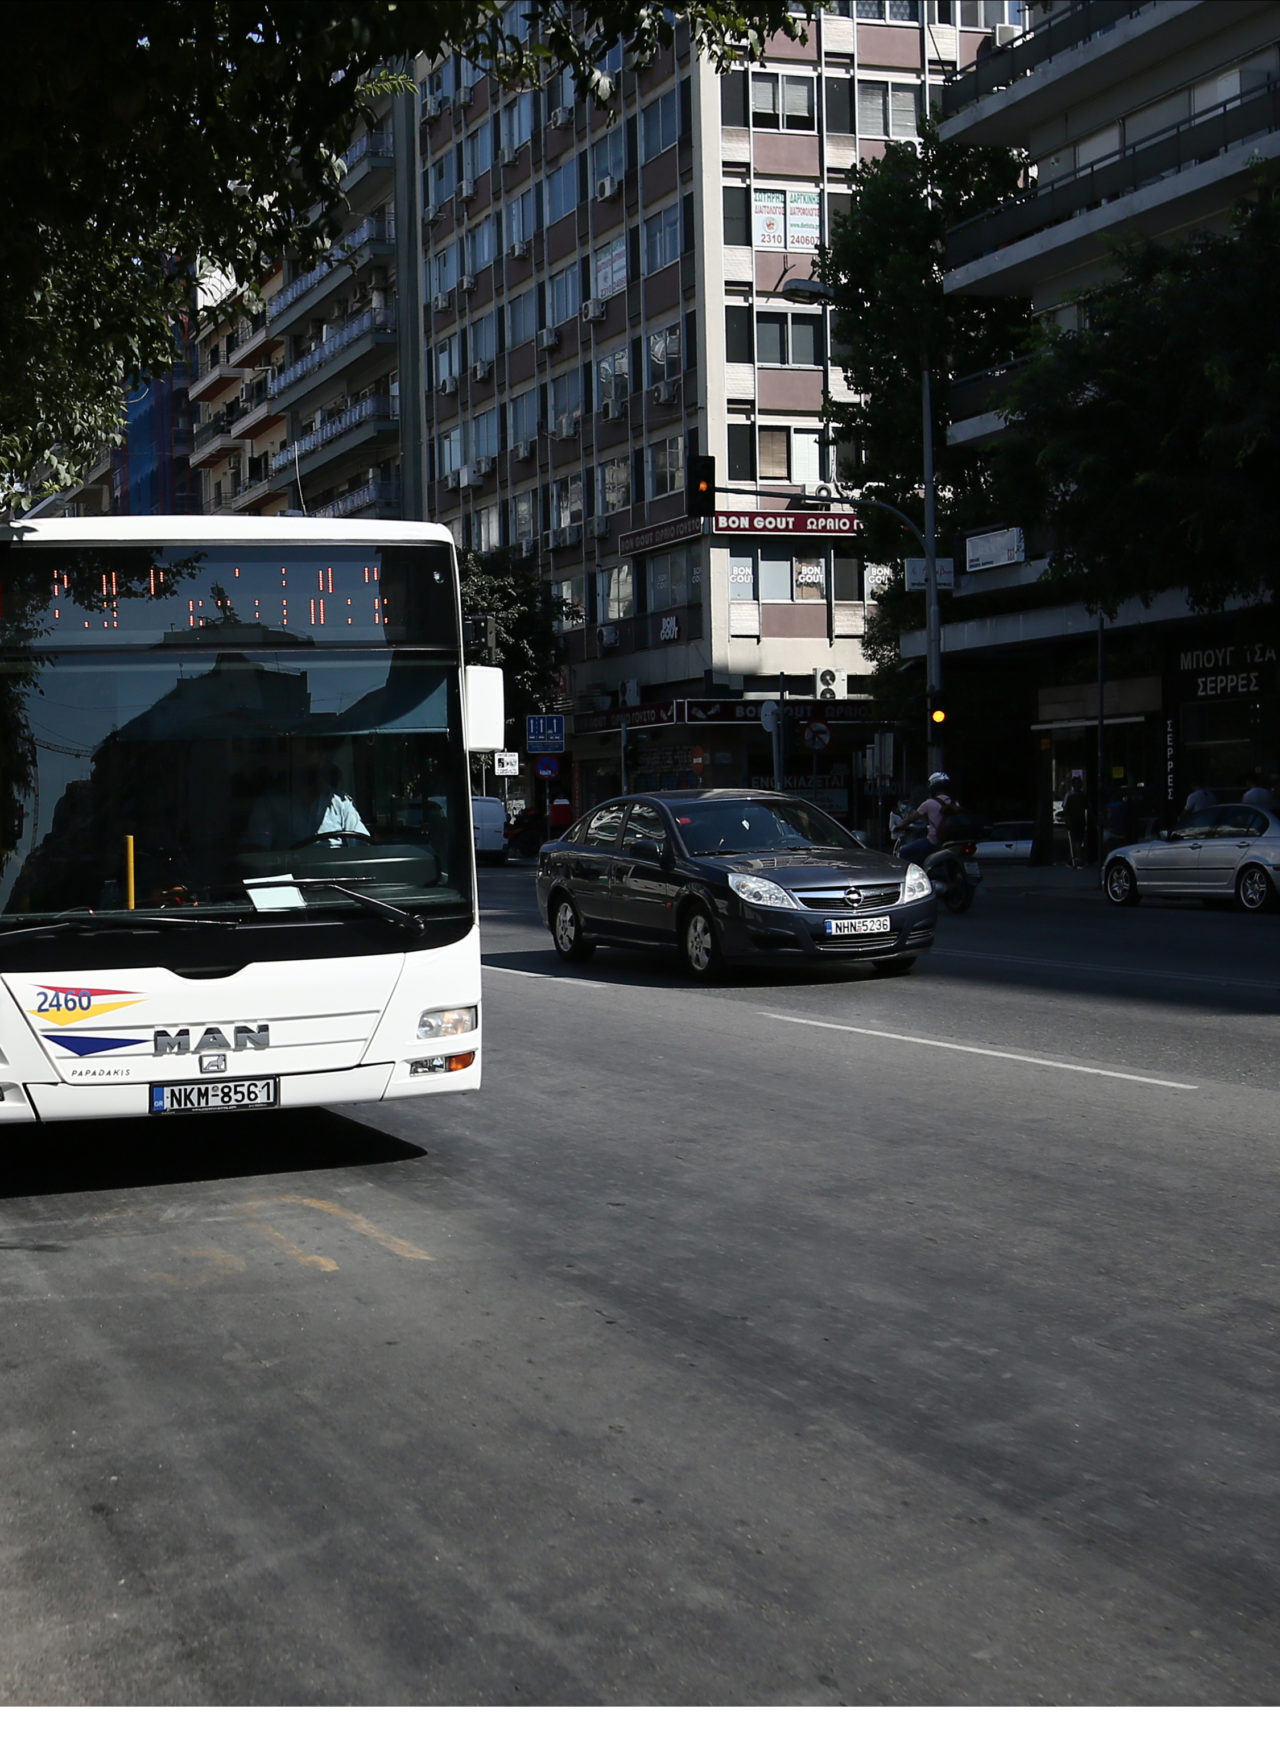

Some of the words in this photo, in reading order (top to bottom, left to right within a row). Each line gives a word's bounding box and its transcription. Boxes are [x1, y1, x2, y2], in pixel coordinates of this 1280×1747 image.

[761, 234, 782, 244] 2310
[718, 516, 750, 529] BON
[753, 517, 794, 529] GOUT
[806, 518, 850, 530] ΩΡΑΙΟ
[732, 566, 752, 575] BON
[801, 566, 821, 575] BON
[871, 567, 890, 576] BON
[798, 573, 824, 583] GOUT
[662, 616, 676, 628] BON
[660, 627, 678, 641] GOUT
[1197, 672, 1259, 696] ΣΕΡΡΕΣ
[1166, 719, 1174, 800] ΣΕΡΡΕΣ
[36, 990, 91, 1013] 2460
[153, 1024, 270, 1056] MAN
[71, 1068, 131, 1077] PAPADAKIS
[170, 1081, 271, 1108] NKM-8561
